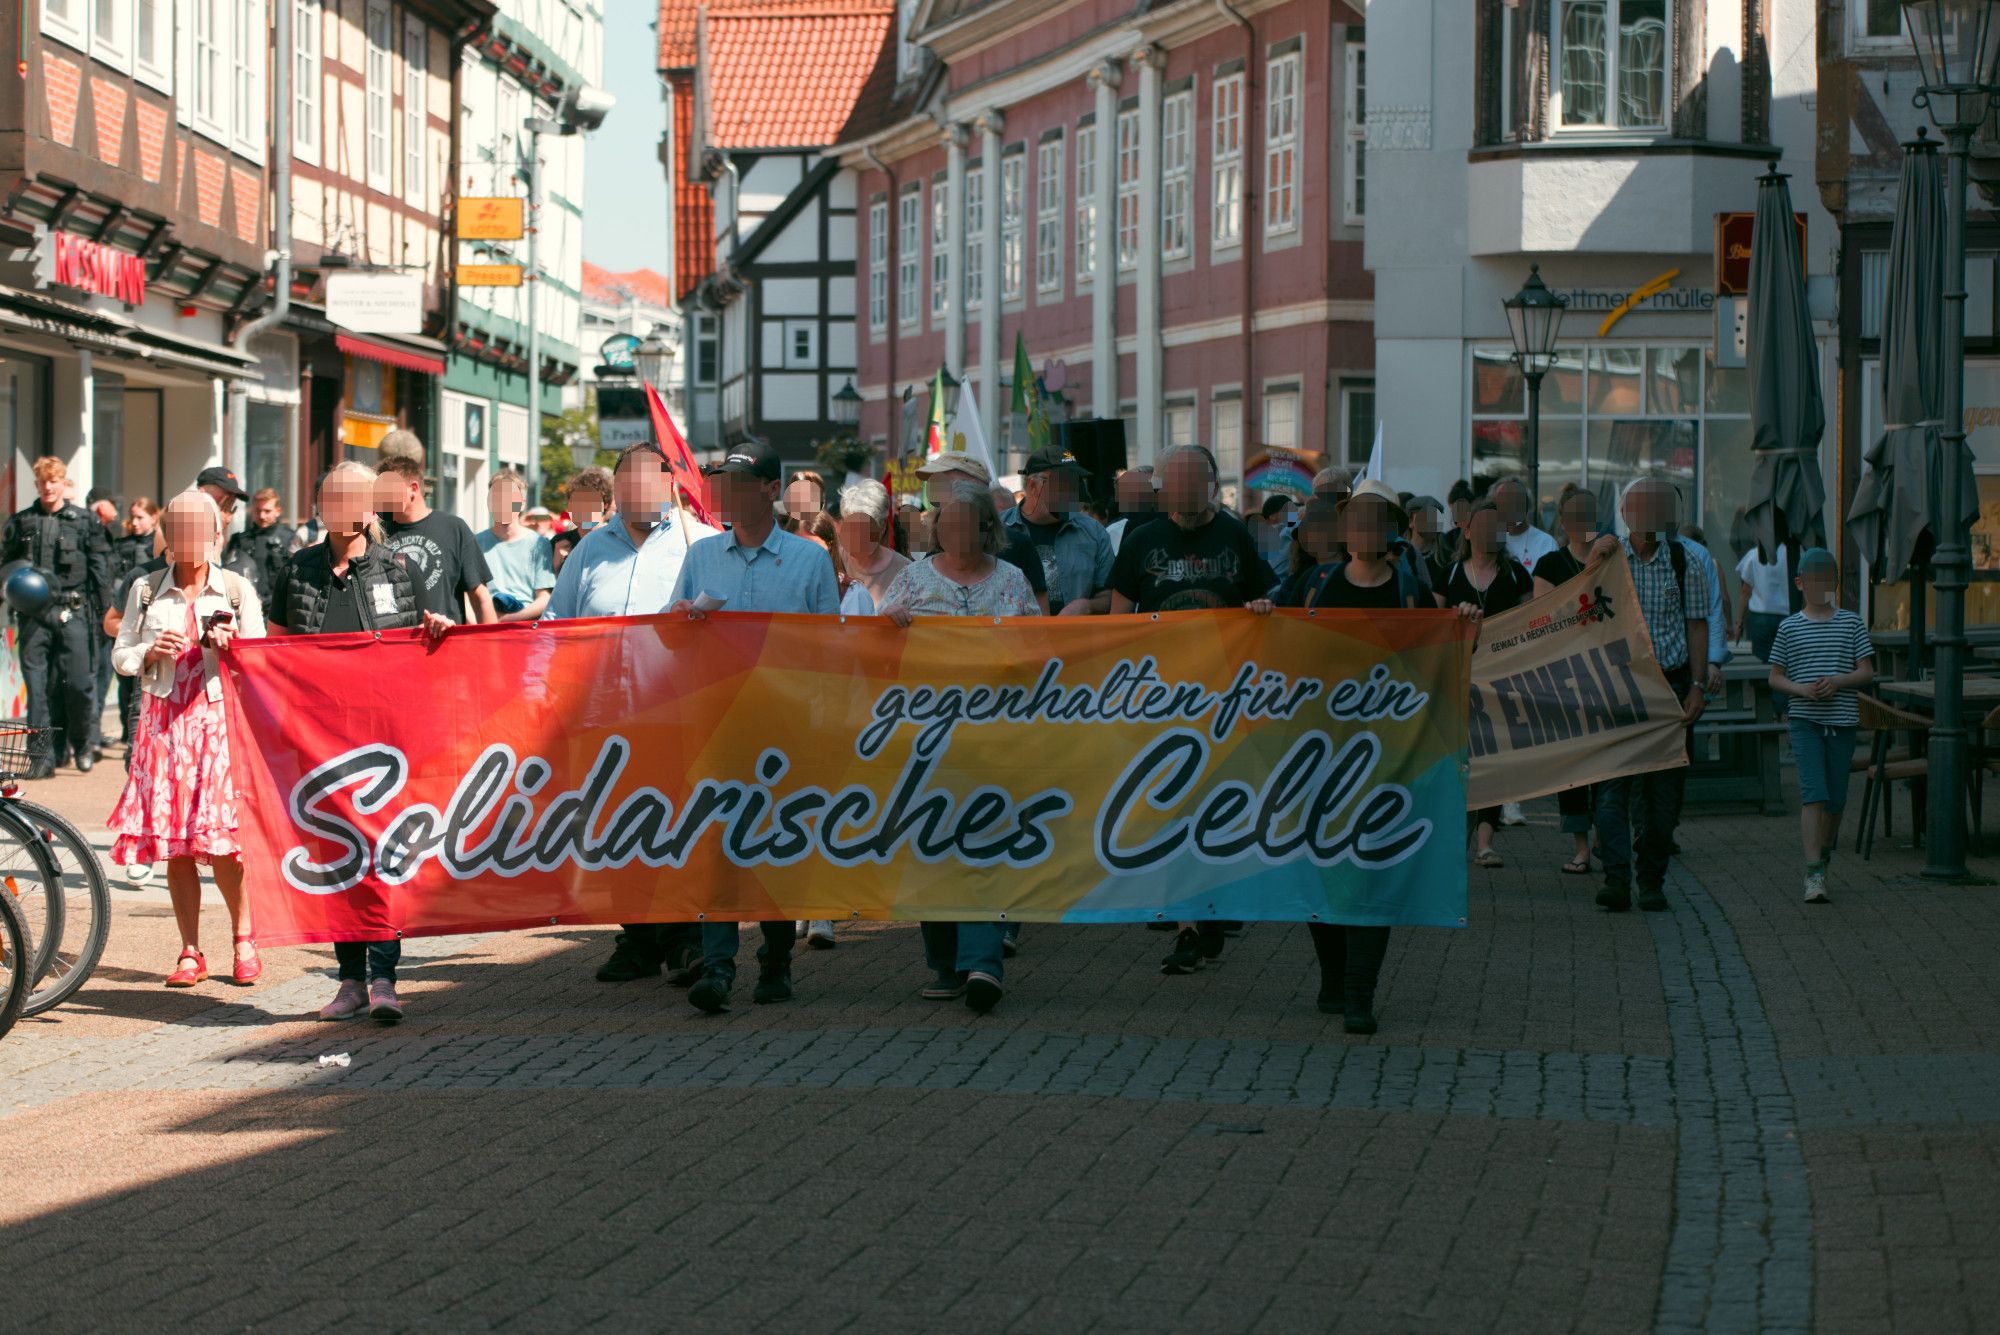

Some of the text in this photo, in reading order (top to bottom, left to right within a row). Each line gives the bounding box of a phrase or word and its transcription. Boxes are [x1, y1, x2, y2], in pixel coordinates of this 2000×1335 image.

[469, 225, 506, 235] LOTTO
[55, 229, 145, 305] ROSSMANN
[465, 270, 512, 282] Presse
[1653, 288, 1716, 308] mülle
[1528, 614, 1552, 630] GEGEN
[1491, 635, 1518, 654] GEWALT
[1519, 631, 1527, 643] &
[1491, 638, 1650, 750] EINFALT
[855, 658, 1430, 760] gegenhalten für ein
[281, 727, 1433, 895] Solidarisches Celle
